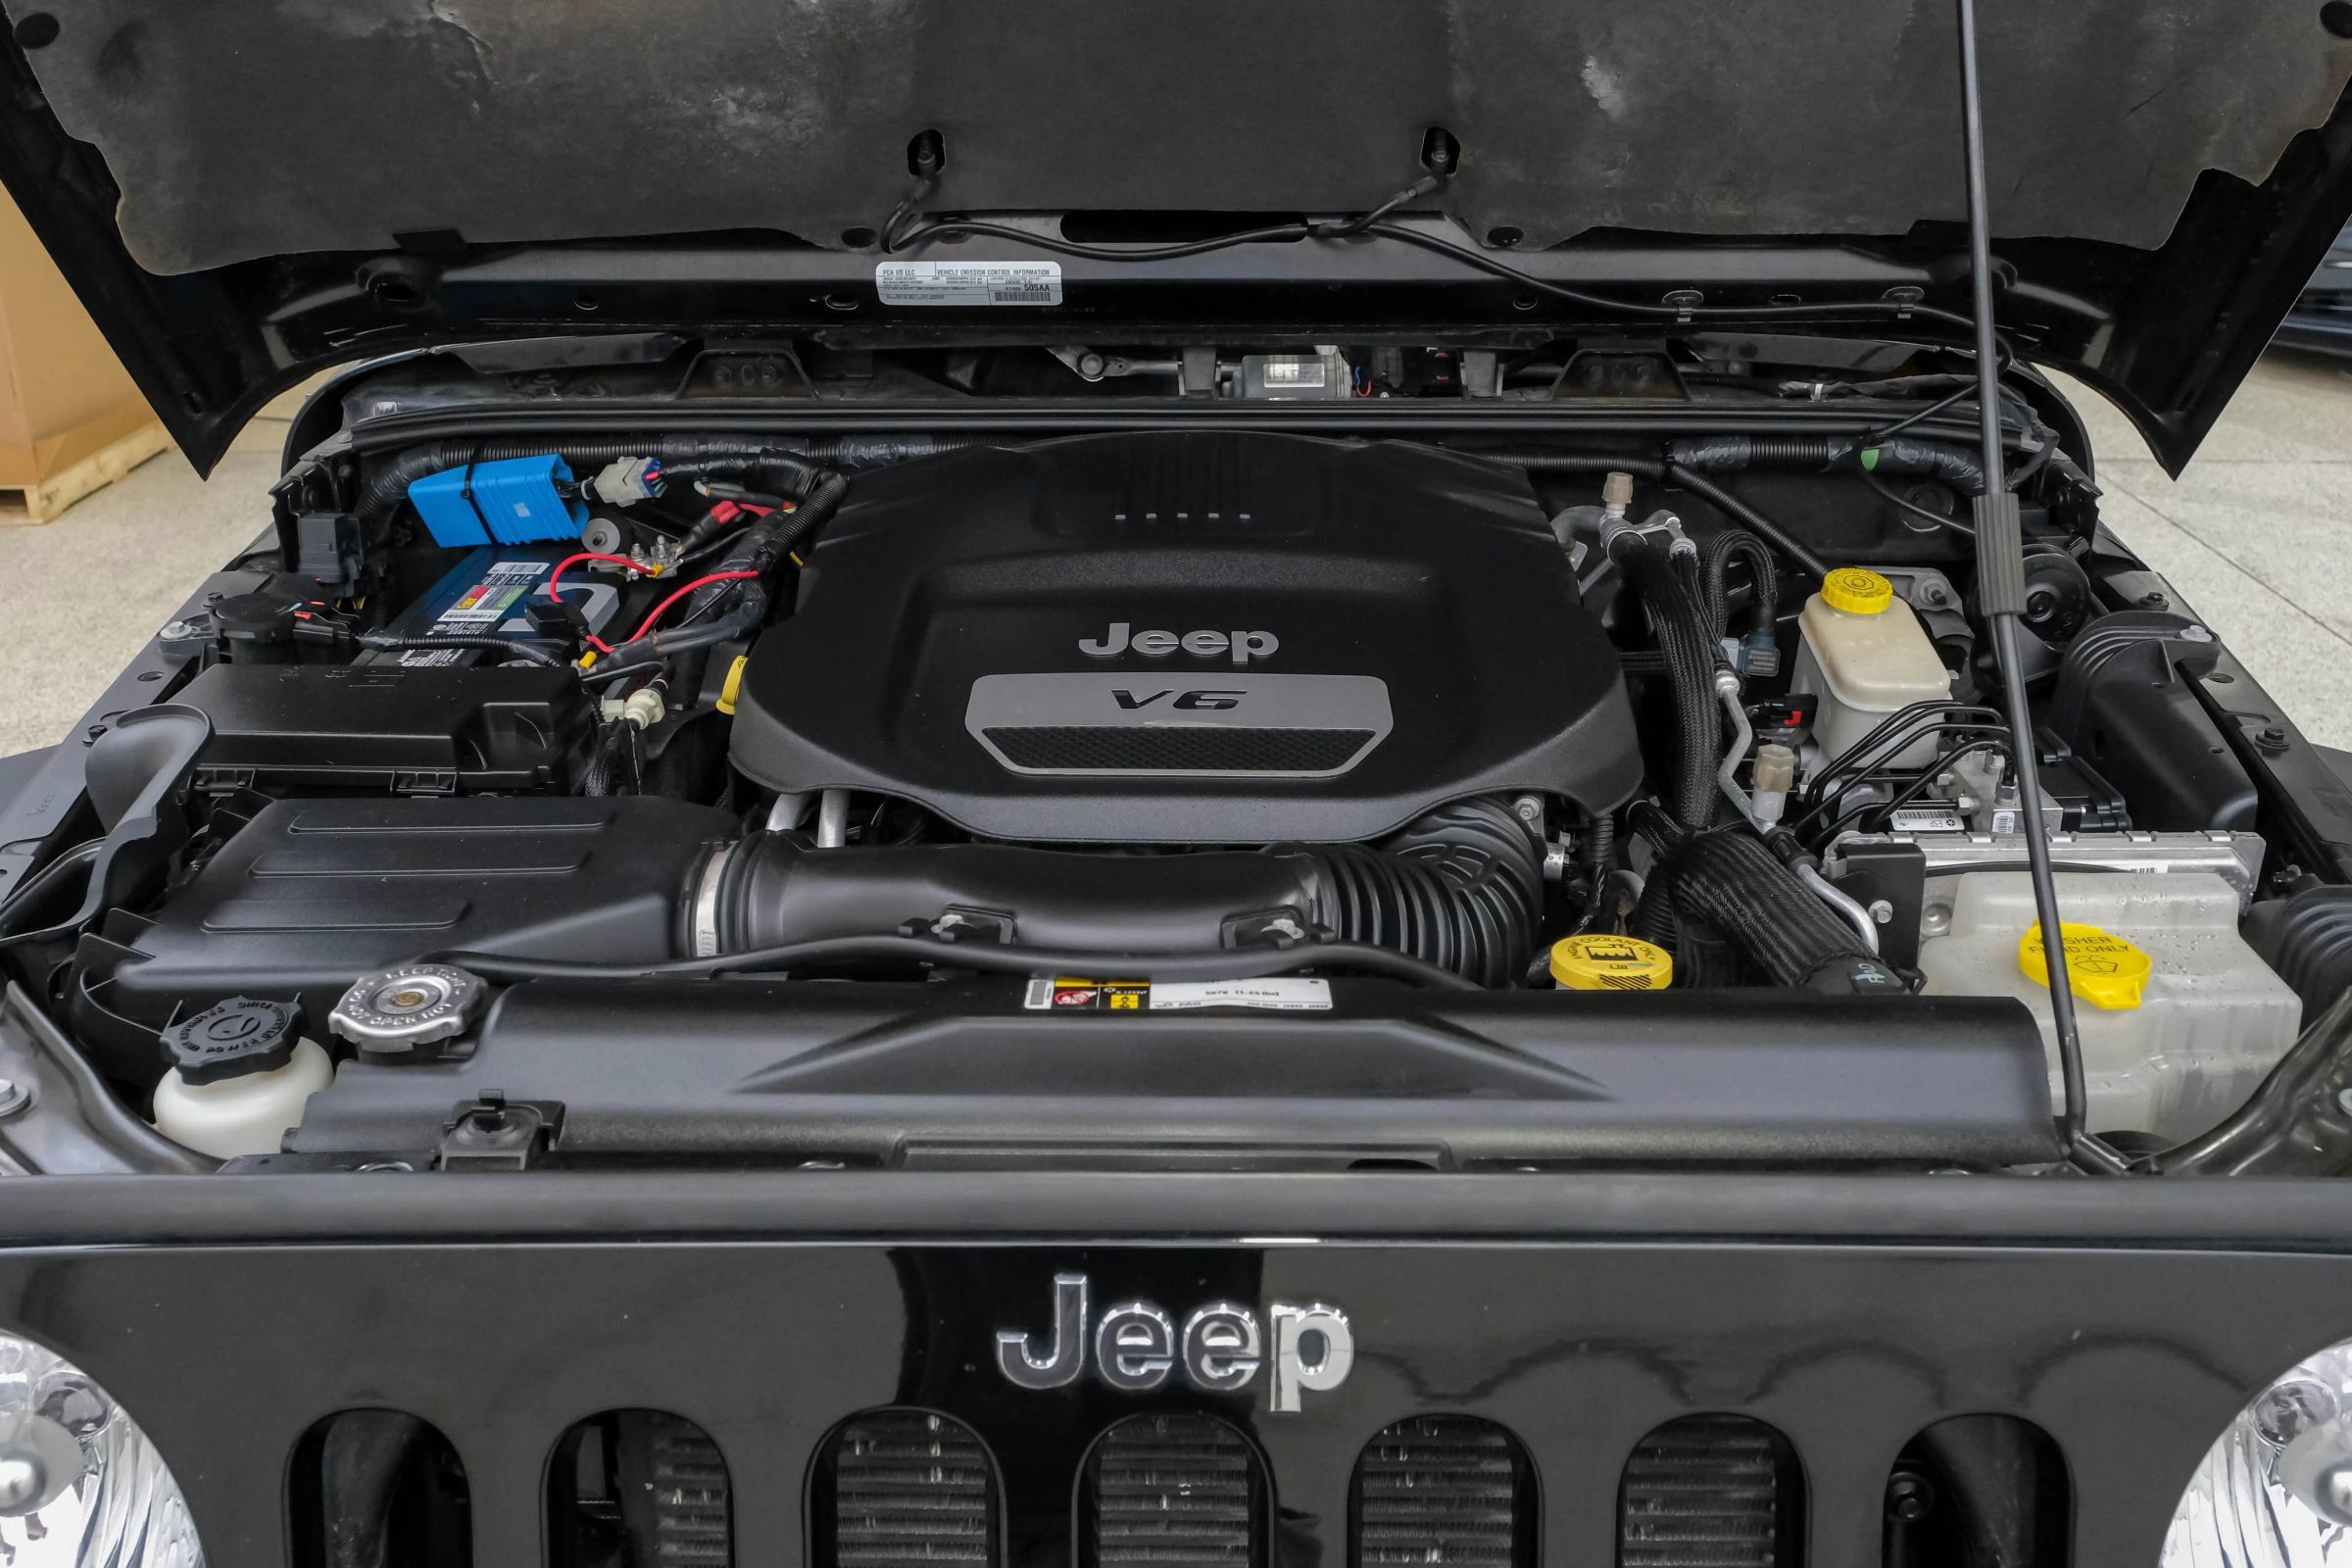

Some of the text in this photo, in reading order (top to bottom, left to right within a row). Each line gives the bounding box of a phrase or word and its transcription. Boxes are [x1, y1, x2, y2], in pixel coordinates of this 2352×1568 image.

[1079, 622, 1280, 664] Jeep
[1110, 689, 1248, 710] V6
[1580, 936, 1642, 948] COOLANT
[2085, 944, 2130, 953] ONLY
[996, 1273, 1354, 1412] Jeep
